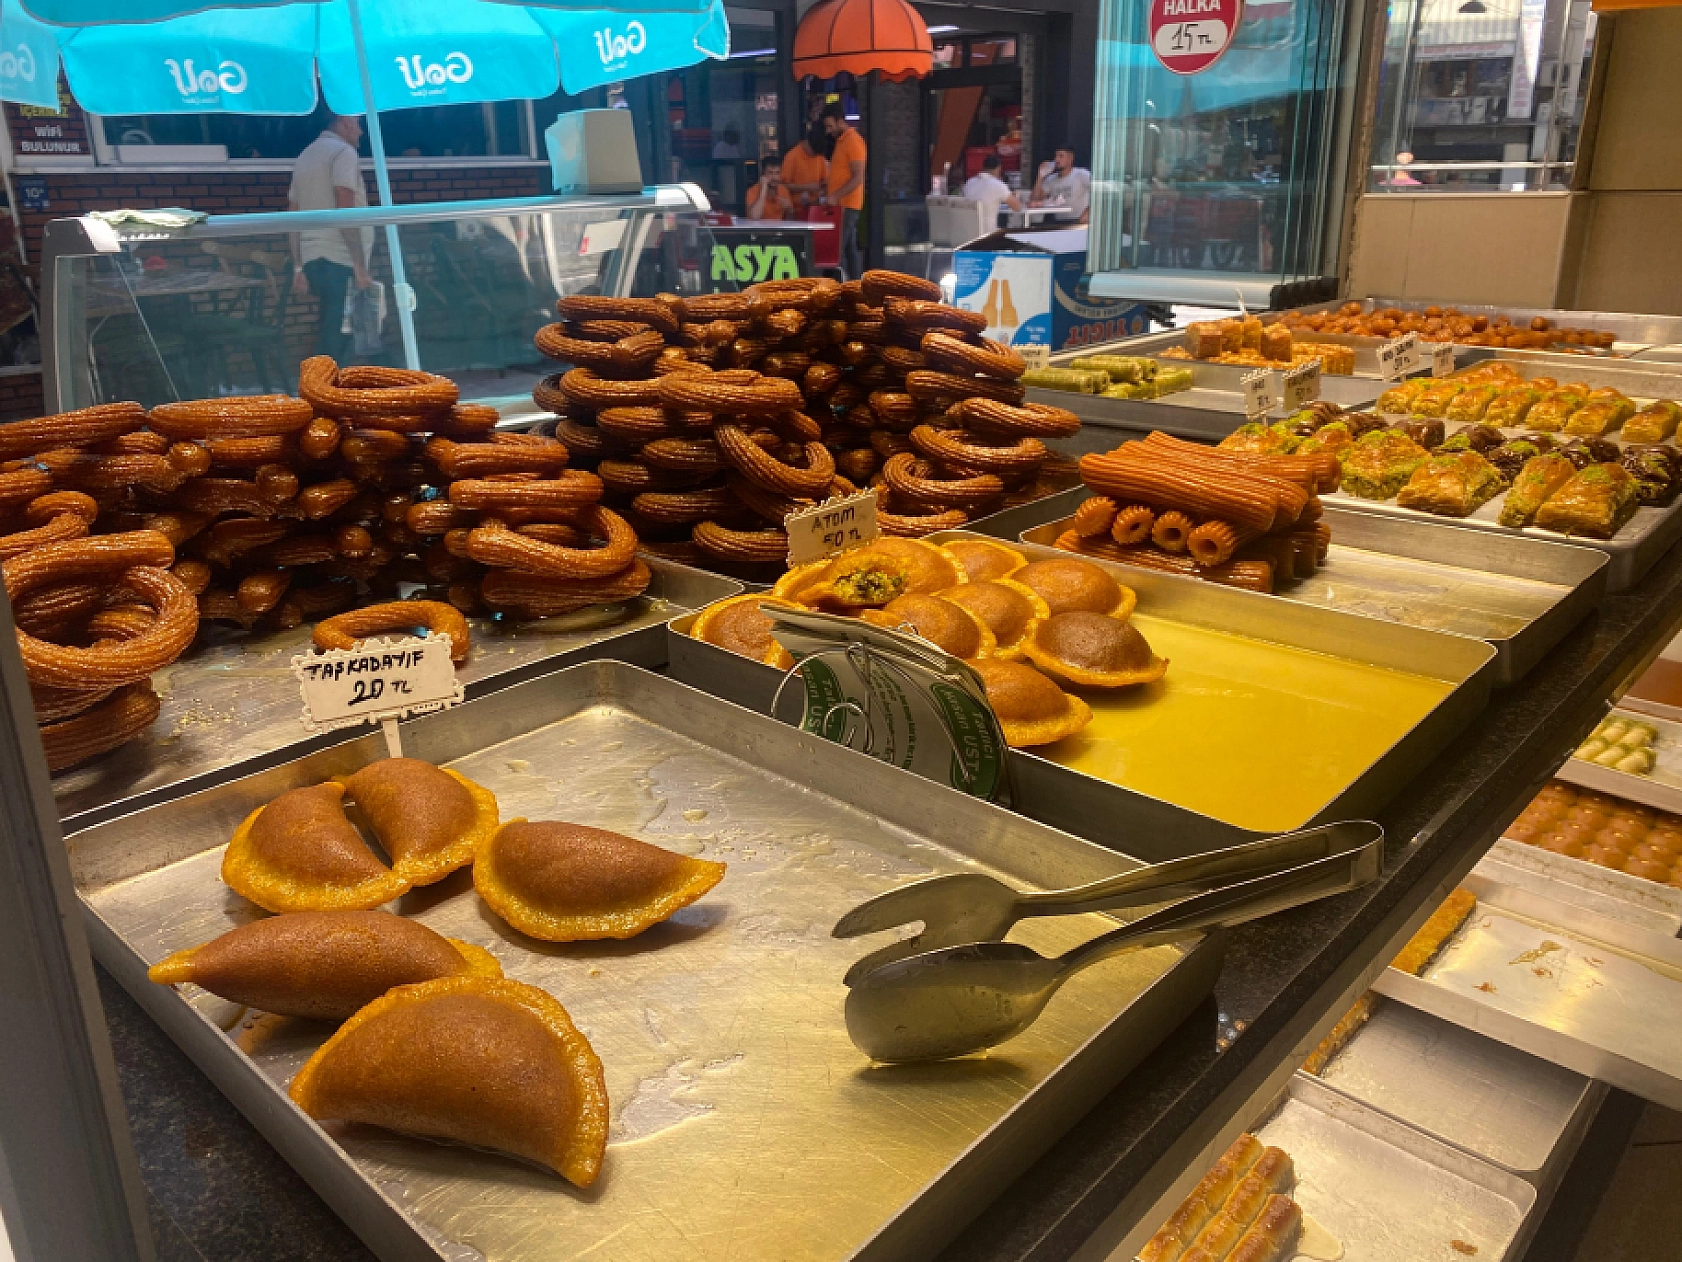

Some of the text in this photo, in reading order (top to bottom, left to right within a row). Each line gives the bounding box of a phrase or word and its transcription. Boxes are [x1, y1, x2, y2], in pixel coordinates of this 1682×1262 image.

[1171, 23, 1199, 52] 15
[711, 244, 799, 282] ASYA
[823, 530, 844, 547] 50
[347, 678, 413, 706] 20 TL
